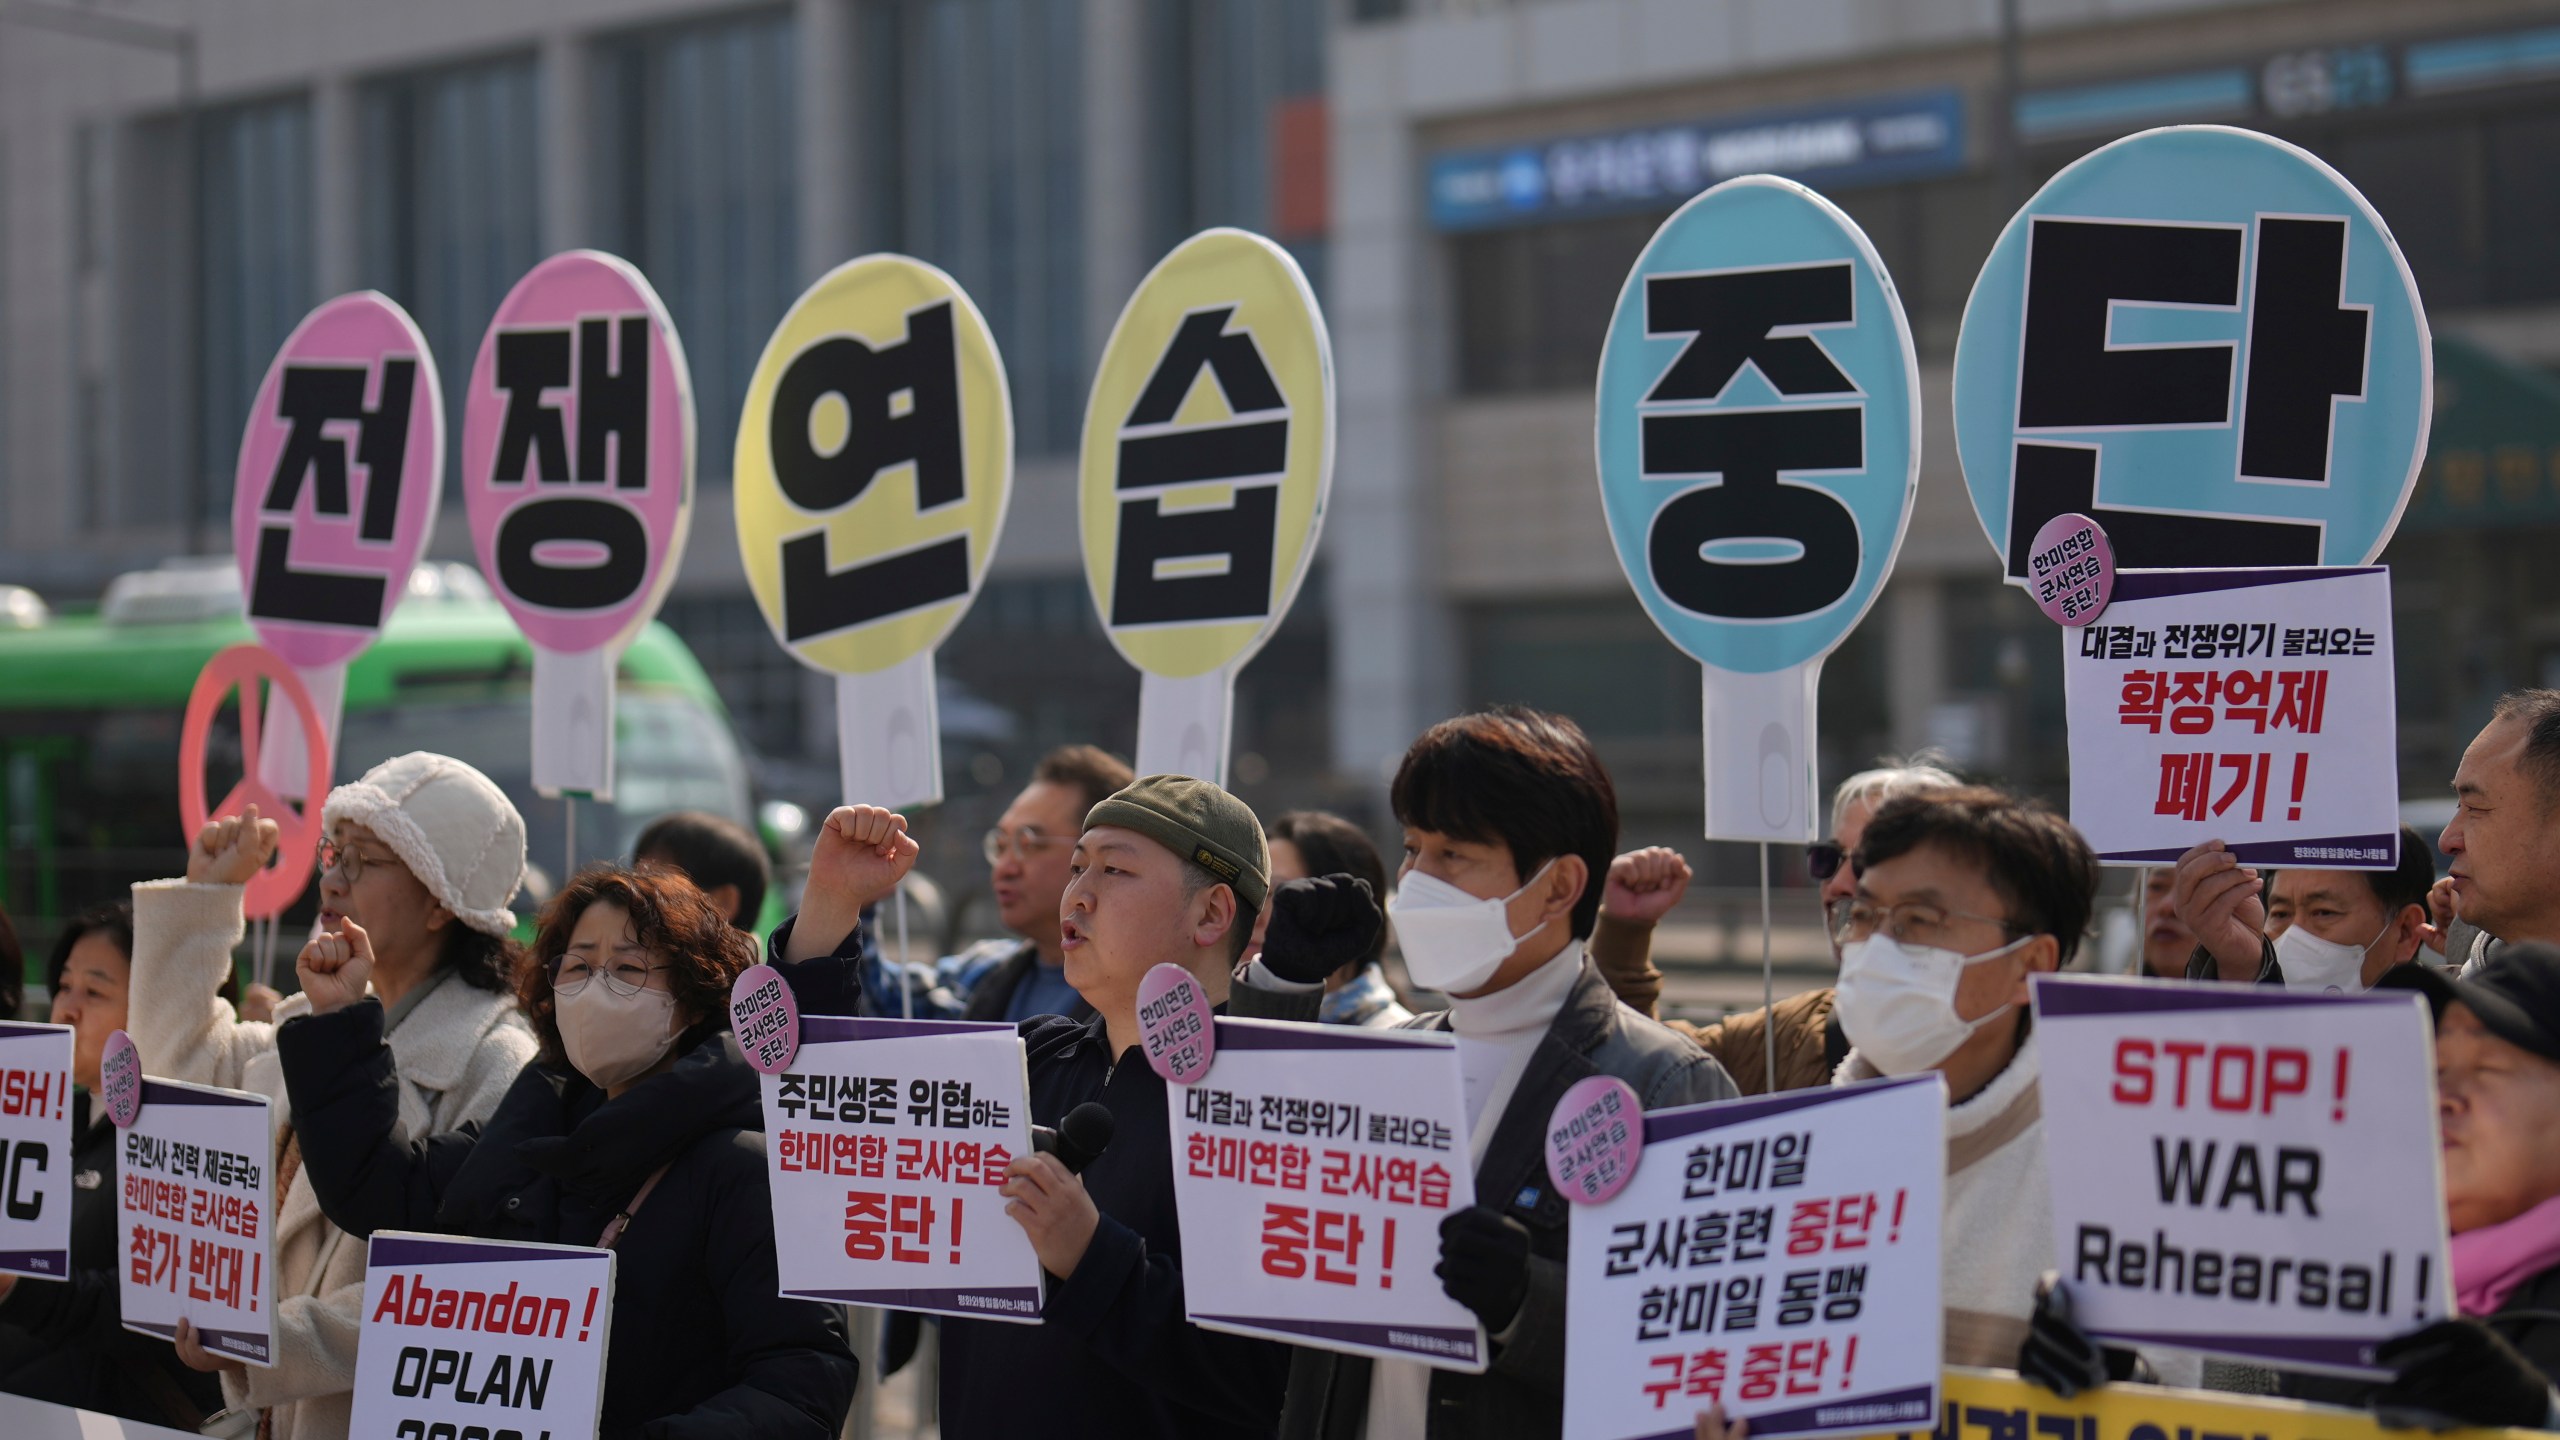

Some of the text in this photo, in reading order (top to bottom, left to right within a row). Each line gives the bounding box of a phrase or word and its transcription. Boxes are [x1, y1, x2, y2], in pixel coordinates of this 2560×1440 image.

[2032, 527, 2095, 577] 한미연합
[2039, 556, 2101, 603] 군사연습
[2080, 623, 2375, 659] 대결과 전쟁위기 불러오는
[2117, 669, 2329, 735] 확장억제
[734, 978, 782, 1025] 한미연합
[740, 1006, 788, 1051] 군사연습
[1140, 981, 1194, 1030] 한미연합
[1148, 1011, 1202, 1058] 군사연습
[778, 1074, 1010, 1129] 주민생존 위협하는
[1185, 1086, 1452, 1152] 대결과 전쟁위기 불러오는
[125, 1131, 261, 1192] 유엔사 전력 제공국의
[779, 1129, 1012, 1186] 한미연합 군사연습
[1187, 1132, 1452, 1210] 한미연합 군사연습
[1682, 1131, 1813, 1200] 한미일
[2152, 1136, 2324, 1217] WAR
[124, 1172, 188, 1223] 한미연합
[190, 1187, 259, 1240] 군사연습
[130, 1223, 182, 1295] 참가
[1604, 1206, 1774, 1278] 군사훈련
[1636, 1263, 1869, 1342] 한미일 동맹
[392, 1345, 554, 1411] OPLAN
[1642, 1349, 1728, 1410] 구축
